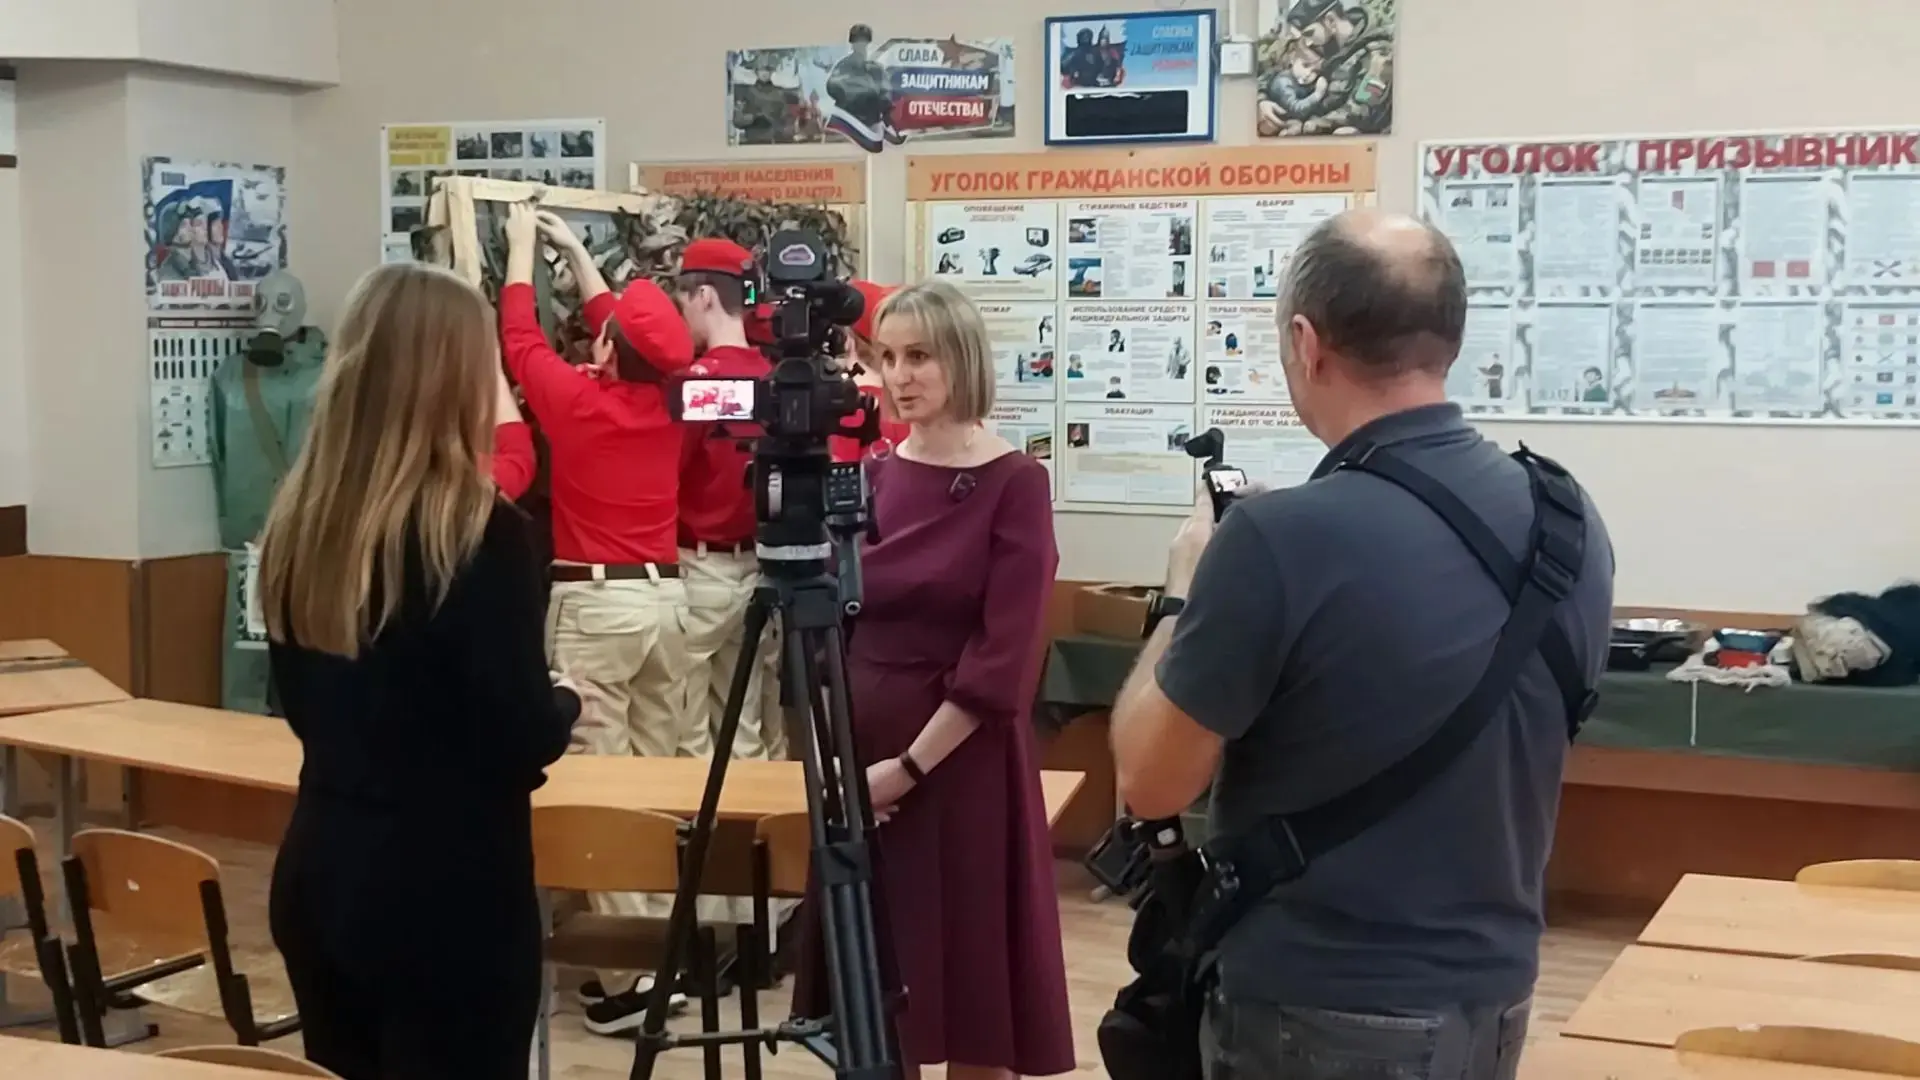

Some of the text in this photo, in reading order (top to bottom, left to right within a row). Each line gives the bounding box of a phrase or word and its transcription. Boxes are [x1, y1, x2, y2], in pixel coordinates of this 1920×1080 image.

[898, 48, 939, 61] СЛАВА
[901, 73, 989, 90] ЗАЩИТНИКАМ
[908, 101, 984, 117] ОТЕЧЕСТВА!
[1433, 134, 1919, 176] УГОЛОК ПРИЗЫВНИК
[664, 168, 835, 185] ДЕЙСТВИЯ НАСЕЛЕНИЯ
[930, 163, 1351, 193] УГОЛОК ГРАЖДАНСКОЙ ОБОРОНЫ
[785, 186, 842, 199] ХАРАКТЕРА
[963, 205, 1025, 213] ОПОВЕЩЕНИЕ
[1078, 201, 1188, 211] СТИХИЙНЫЕ БЕДСТВИЯ
[1069, 315, 1191, 323] ИНДИВИДУАЛЬНОЙ ЗАЩИТЫ
[1104, 407, 1154, 415] ЭВАКУАЦИЯ
[1211, 409, 1278, 417] ГРАЖДАНСКАЯ
[1209, 418, 1246, 426] ЗАЩИТА
